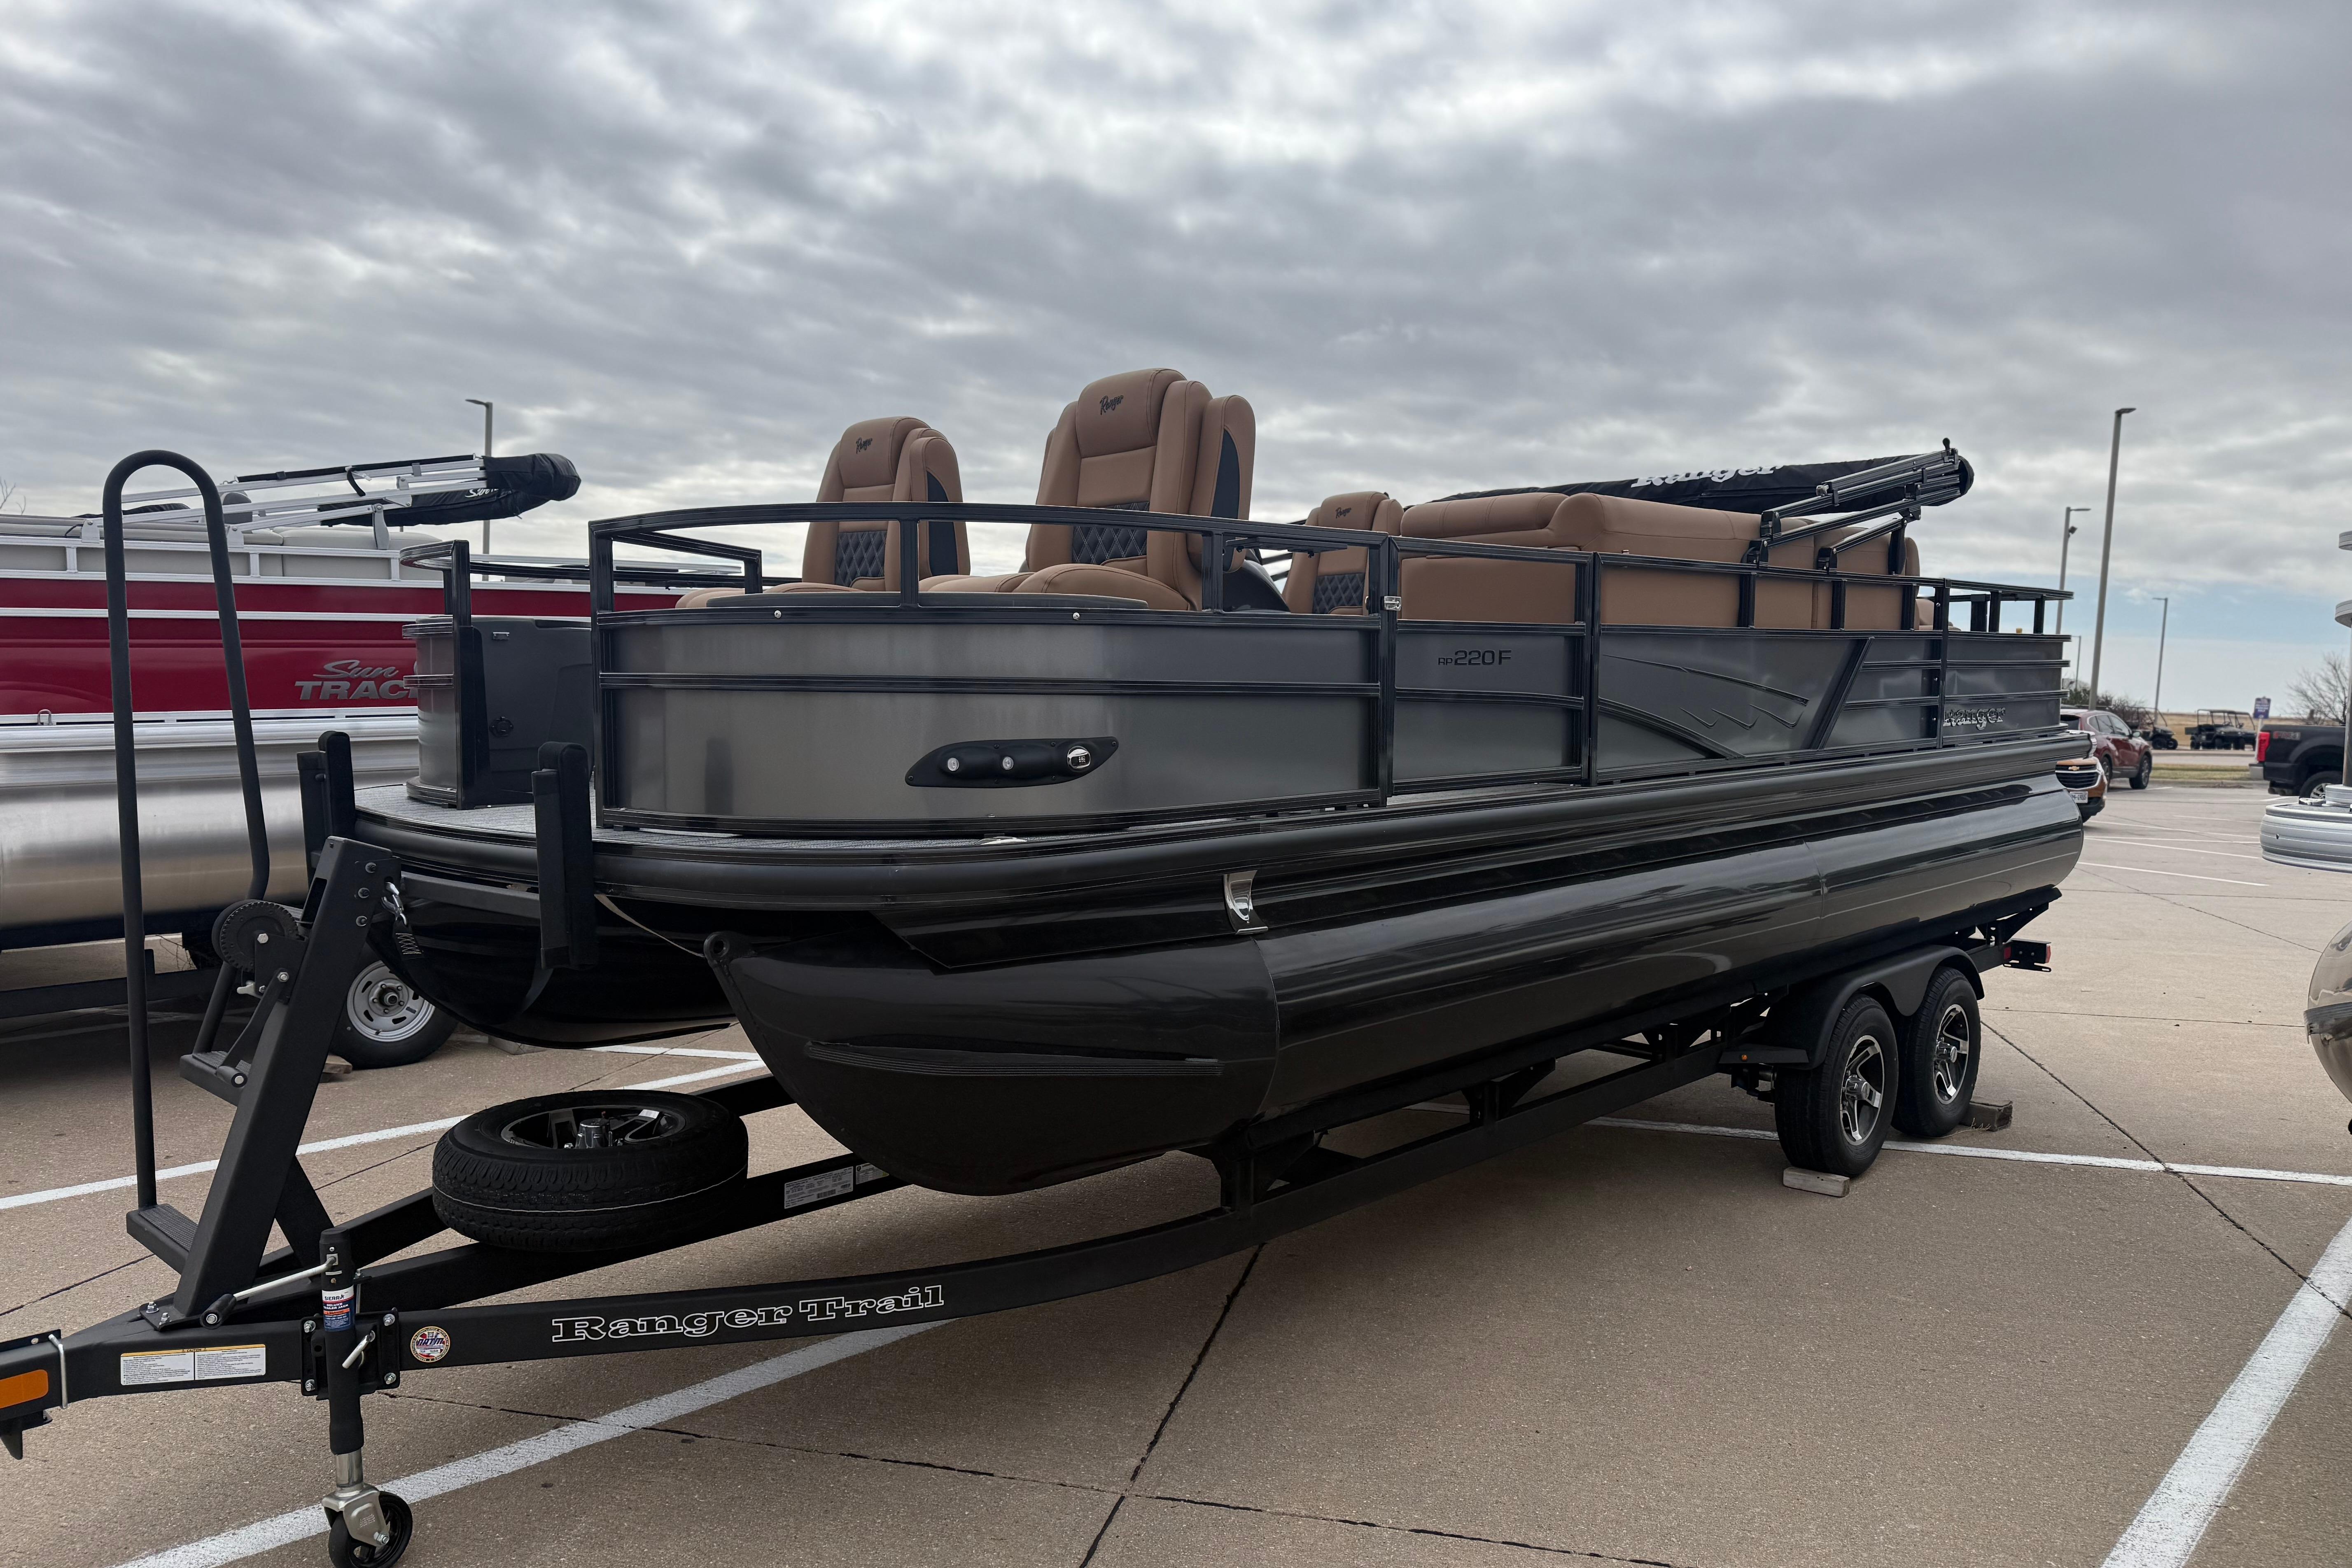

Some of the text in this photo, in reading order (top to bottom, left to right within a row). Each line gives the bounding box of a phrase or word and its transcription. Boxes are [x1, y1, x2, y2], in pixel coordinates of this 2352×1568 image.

[1099, 394, 1124, 415] Ranger
[313, 660, 399, 678] Sun
[295, 680, 418, 700] TRAC
[1943, 707, 2006, 730] Ranger
[552, 1285, 945, 1342] Ranger Trail
